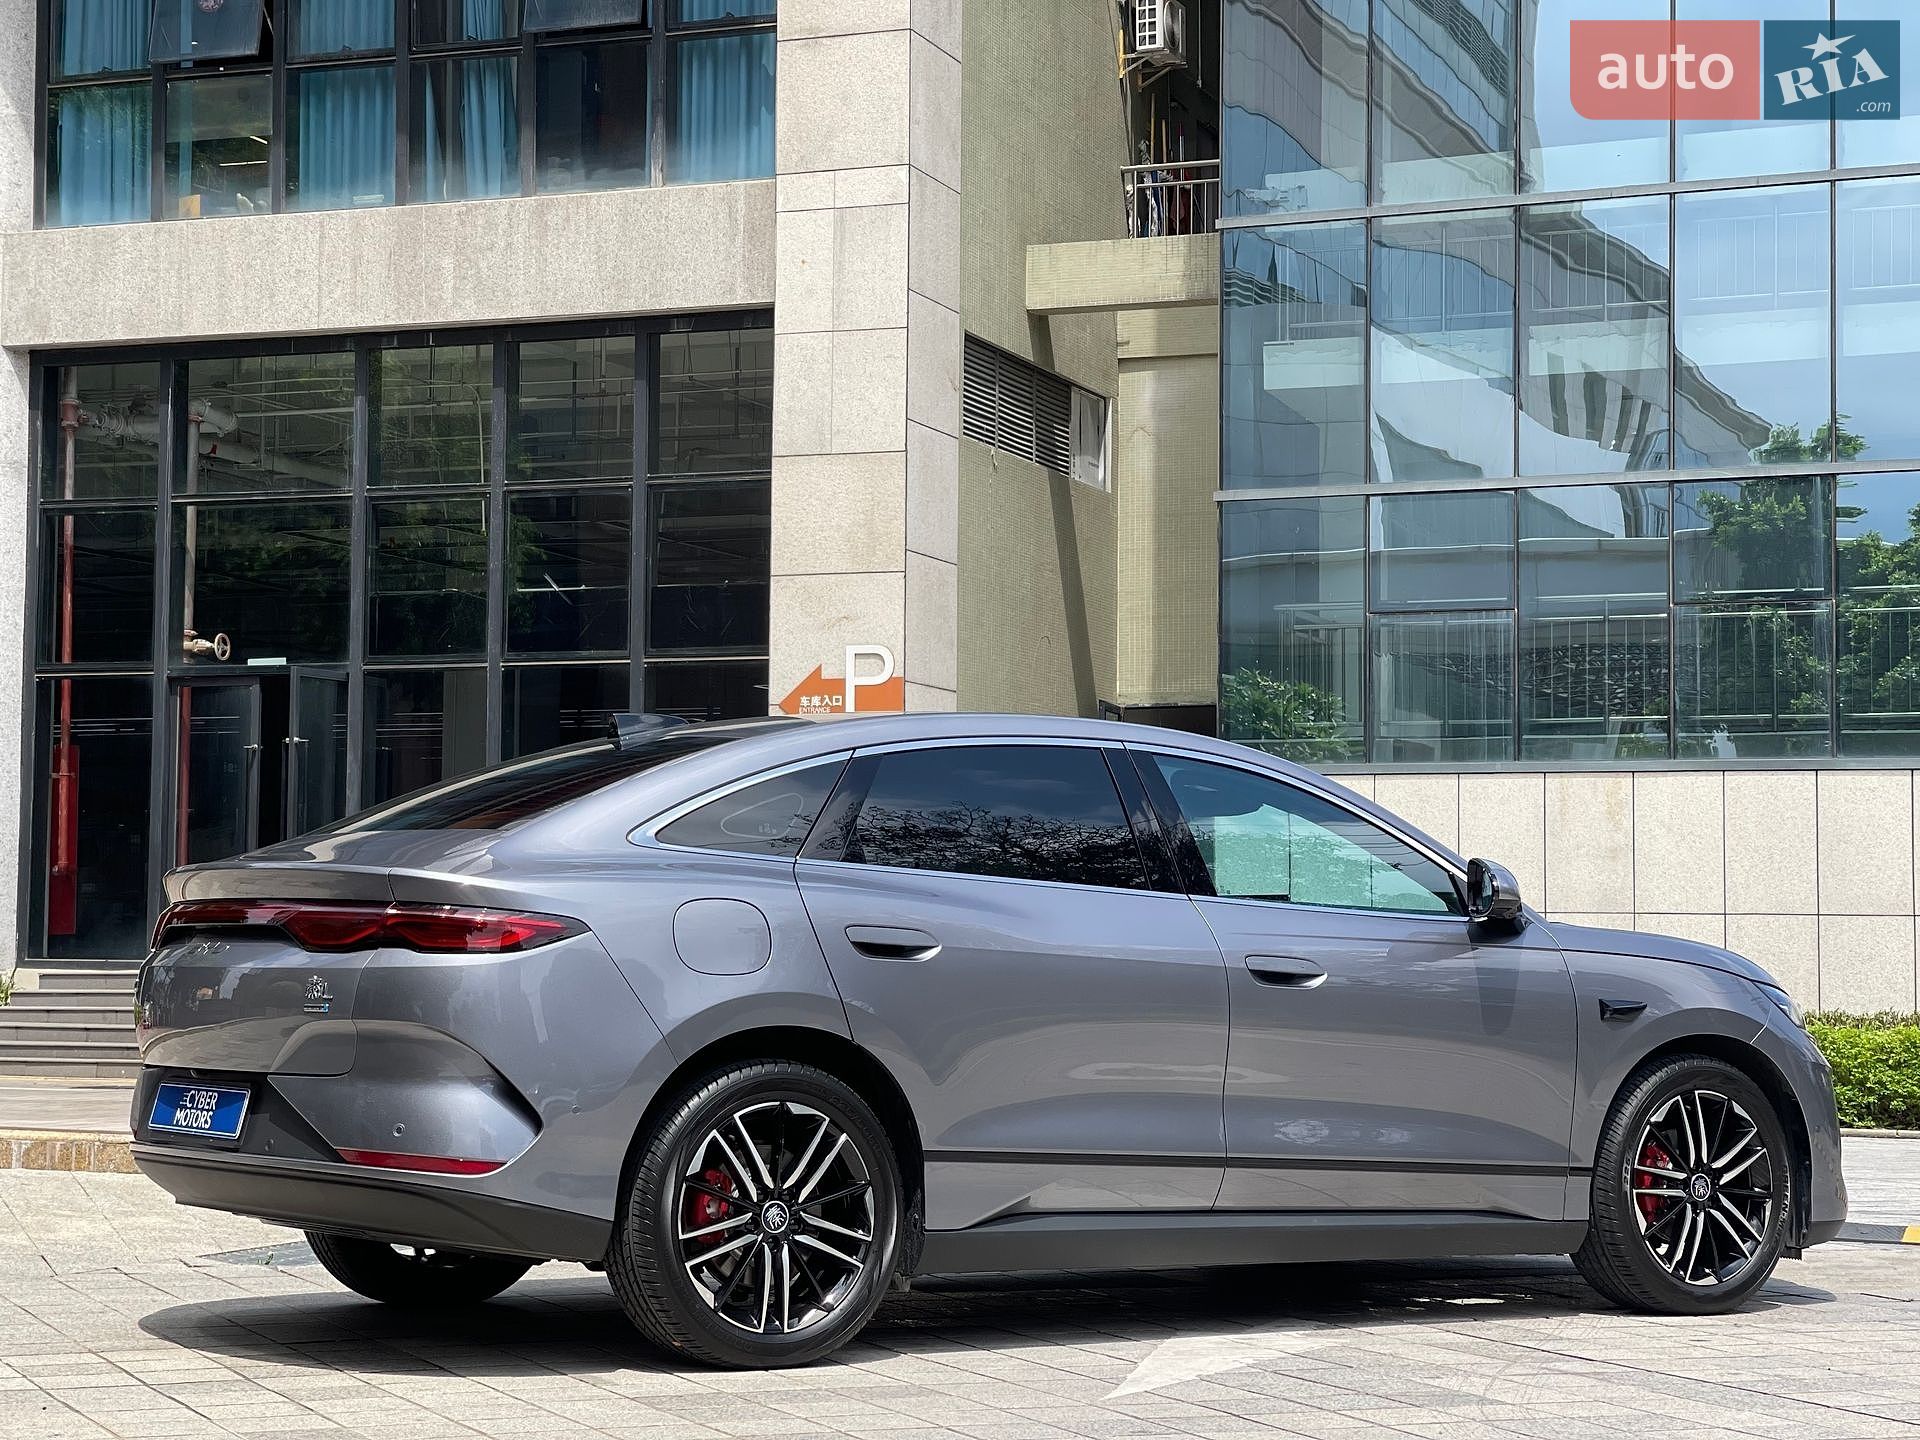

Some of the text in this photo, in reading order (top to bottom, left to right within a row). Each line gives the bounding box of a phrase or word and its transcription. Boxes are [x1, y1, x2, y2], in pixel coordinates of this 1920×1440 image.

[845, 644, 895, 713] P
[799, 706, 831, 714] ENTRANCE
[800, 695, 843, 707] 车库入口
[186, 1090, 218, 1110] CYBER
[173, 1108, 213, 1129] MOTORS
